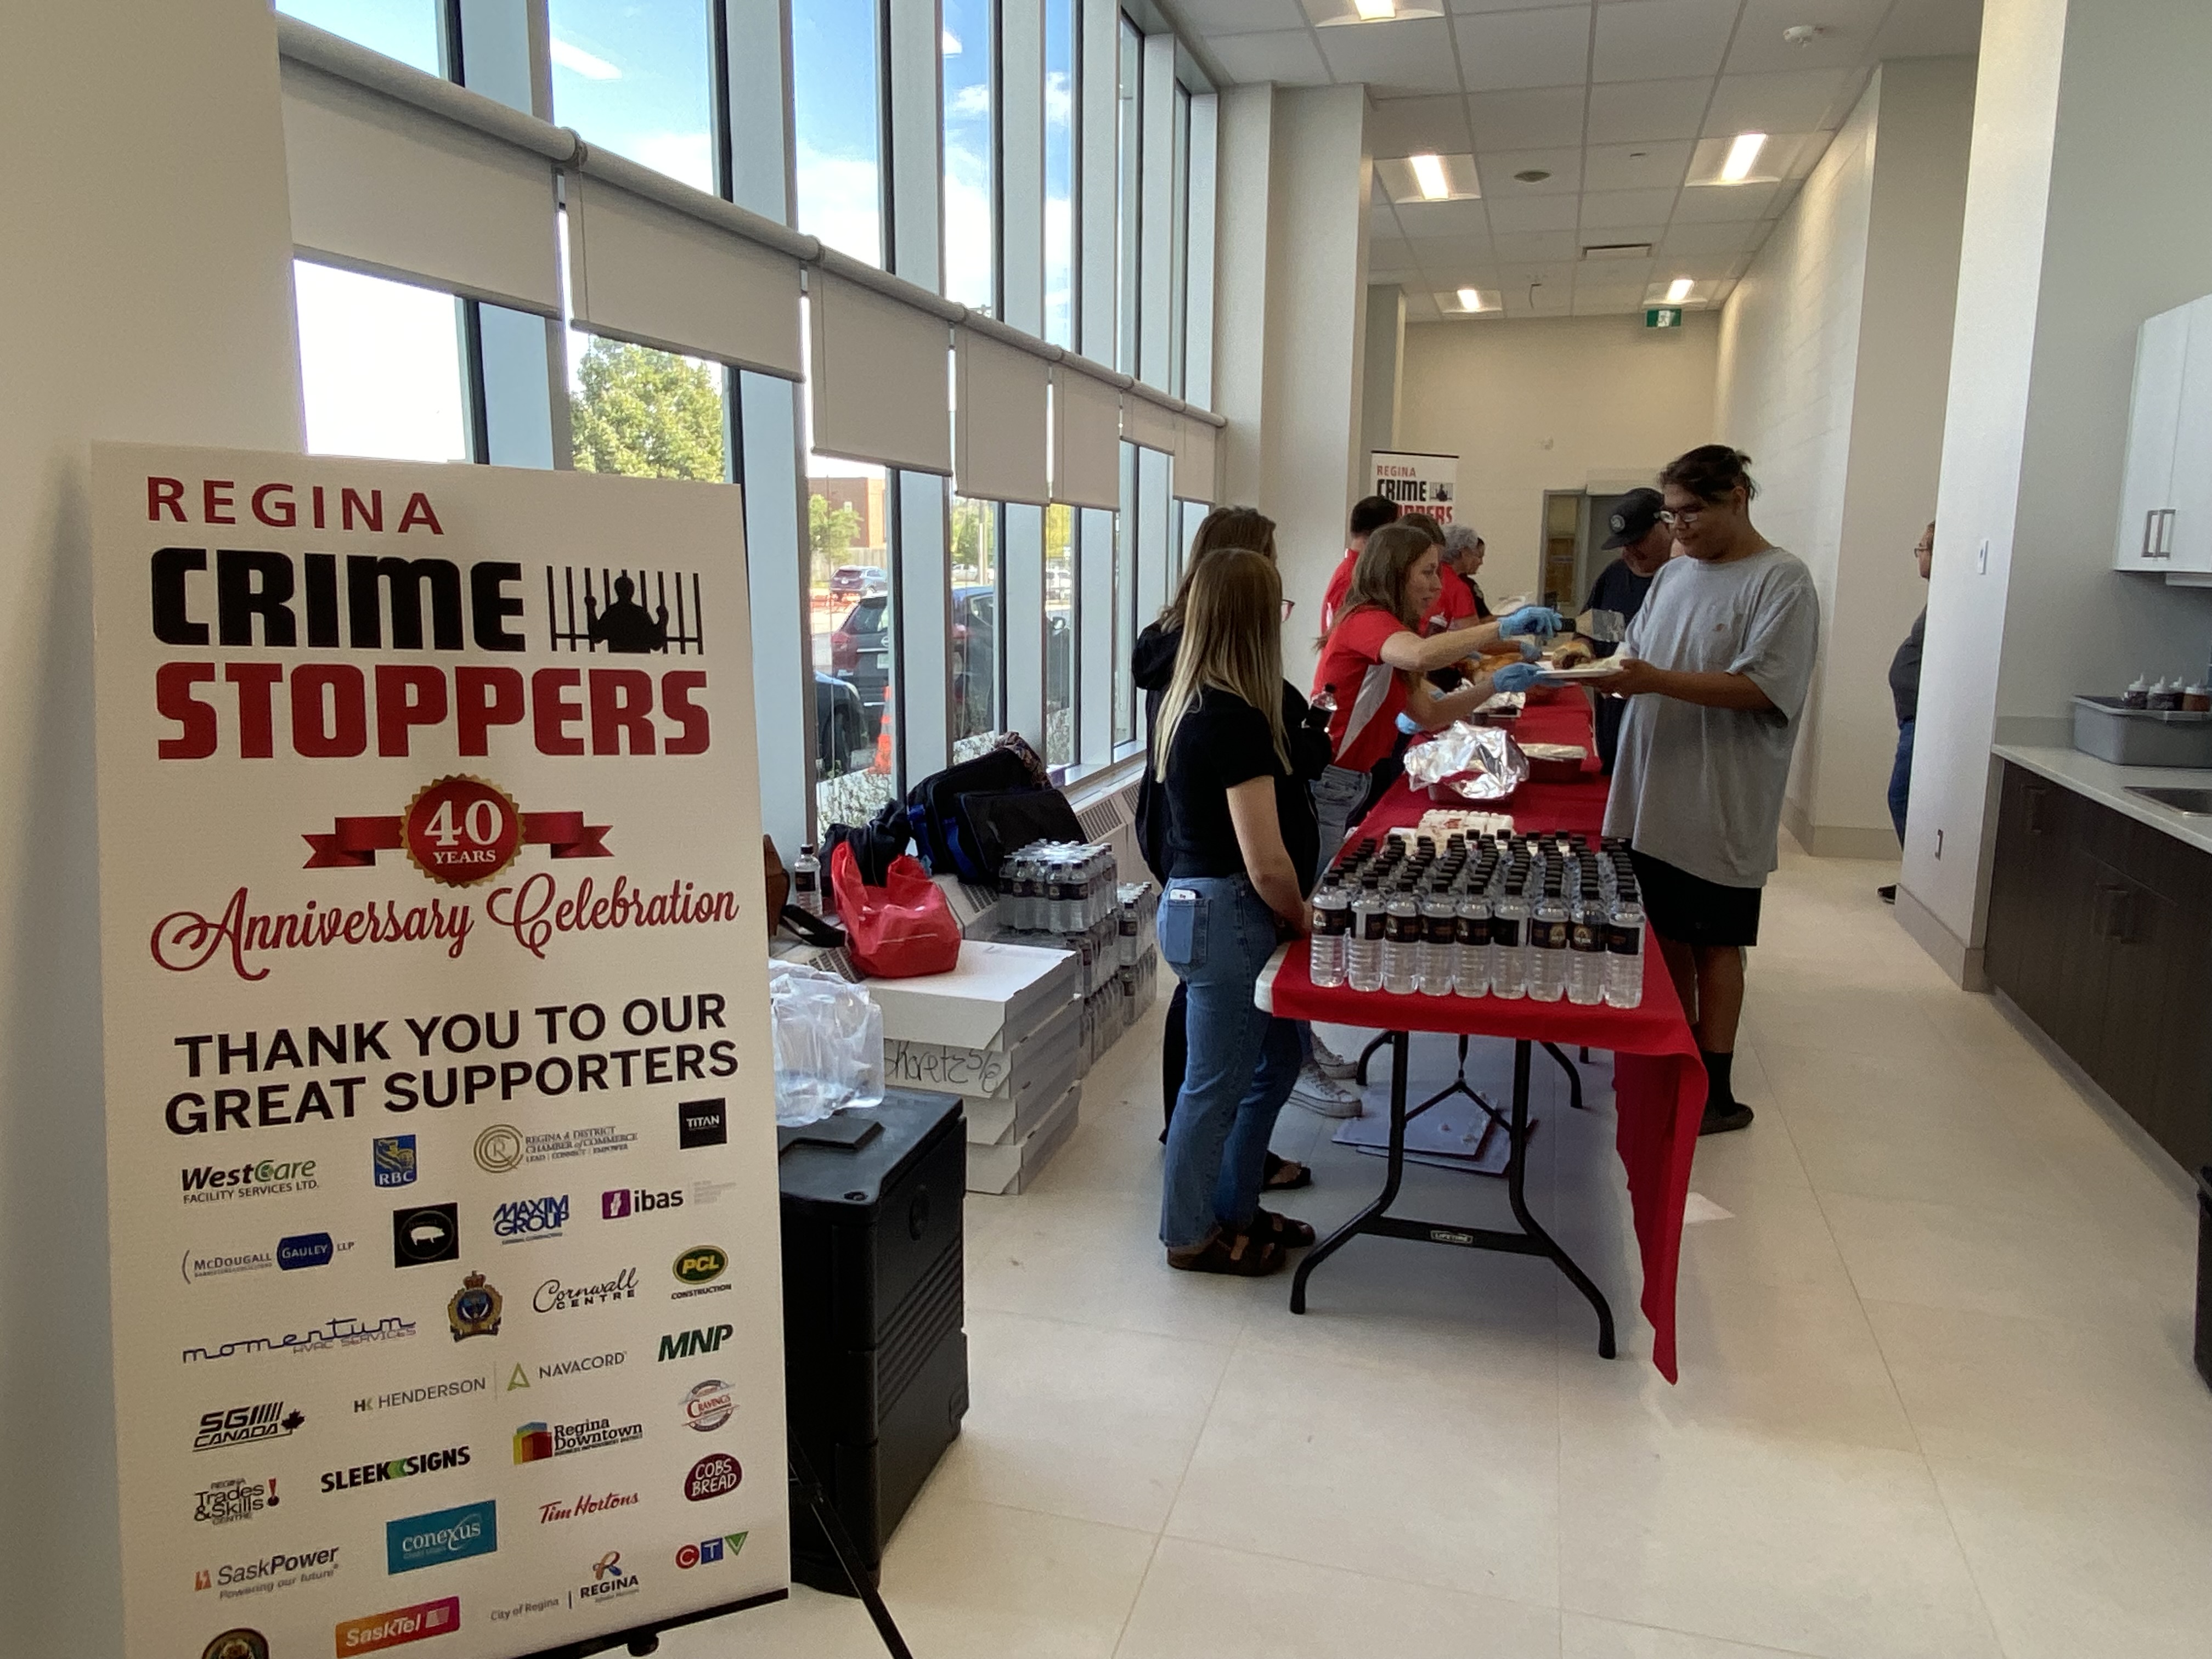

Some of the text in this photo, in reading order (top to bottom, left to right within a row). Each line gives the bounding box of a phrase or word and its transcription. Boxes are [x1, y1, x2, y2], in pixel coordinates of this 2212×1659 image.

[1376, 465, 1417, 477] REGINA
[1377, 479, 1427, 501] CRIME
[148, 476, 444, 535] REGINA
[151, 548, 526, 652] CRIME
[156, 662, 710, 760] STOPPERS
[424, 799, 503, 847] 40
[432, 849, 497, 866] YEARS
[151, 873, 739, 981] Anniversary Celebration
[174, 992, 727, 1078] THANK YOU TO OUR
[165, 1040, 739, 1135] GREAT SUPPORTERS
[526, 1133, 562, 1144] REGINA
[573, 1126, 616, 1139] DISTRICT
[686, 1115, 720, 1128] TITAN
[526, 1141, 573, 1154] CHAMBER
[182, 1159, 317, 1191] WestCare
[378, 1170, 415, 1186] RBC
[183, 1189, 234, 1204] FACILITY
[239, 1182, 292, 1198] SERVICES
[634, 1189, 684, 1212] ibas
[493, 1194, 568, 1221] MAXIM
[494, 1211, 569, 1236] GROUP
[281, 1244, 329, 1259] GAULEY
[337, 1242, 355, 1251] LLP
[682, 1254, 720, 1274] PCL
[533, 1267, 639, 1313] Cornwall
[556, 1289, 635, 1310] CENTRE
[671, 1284, 732, 1300] CONSTRUCTION
[183, 1317, 416, 1364] momentum
[293, 1327, 416, 1354] HVAC SERVICES
[658, 1324, 733, 1362] MNP
[539, 1352, 625, 1379] NAVACORD
[379, 1378, 486, 1409] HENDERSON
[193, 1424, 278, 1448] CANADA
[554, 1419, 610, 1437] Regina
[555, 1424, 643, 1451] Downtown
[321, 1446, 471, 1493] SLEEK SIGNS
[695, 1458, 732, 1480] COBS
[194, 1483, 264, 1505] Trades
[691, 1472, 738, 1497] BREAD
[539, 1492, 639, 1524] Tim Hortons
[403, 1521, 481, 1551] conexus
[676, 1531, 748, 1569] CTV
[218, 1547, 340, 1585] SaskPower
[580, 1575, 639, 1599] REGINA
[490, 1598, 559, 1621] City of Regina
[346, 1613, 422, 1647] SaskTel
